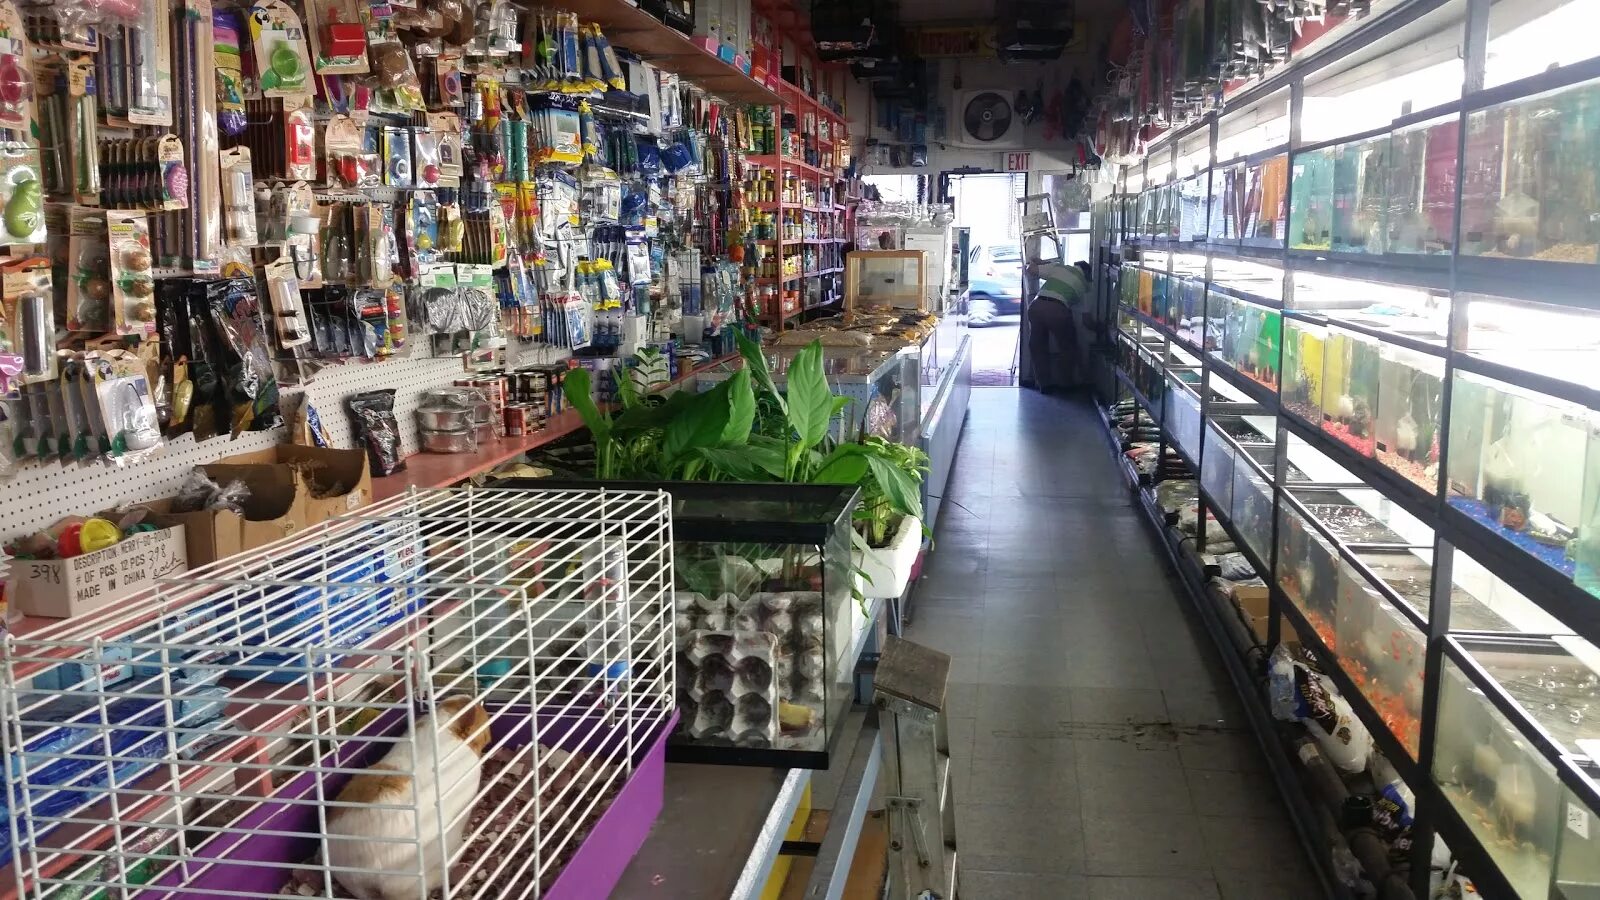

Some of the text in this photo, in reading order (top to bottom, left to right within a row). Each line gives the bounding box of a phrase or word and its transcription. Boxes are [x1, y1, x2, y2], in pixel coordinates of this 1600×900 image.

[1008, 153, 1030, 170] EXIT
[121, 528, 172, 554] MERRY-GO-ROUND
[149, 543, 166, 568] 398
[30, 564, 61, 584] 398
[85, 570, 95, 583] OF
[100, 564, 118, 579] PCS:
[121, 559, 128, 571] 12
[130, 554, 146, 568] PCS
[77, 569, 146, 602] MADE IN CHINA
